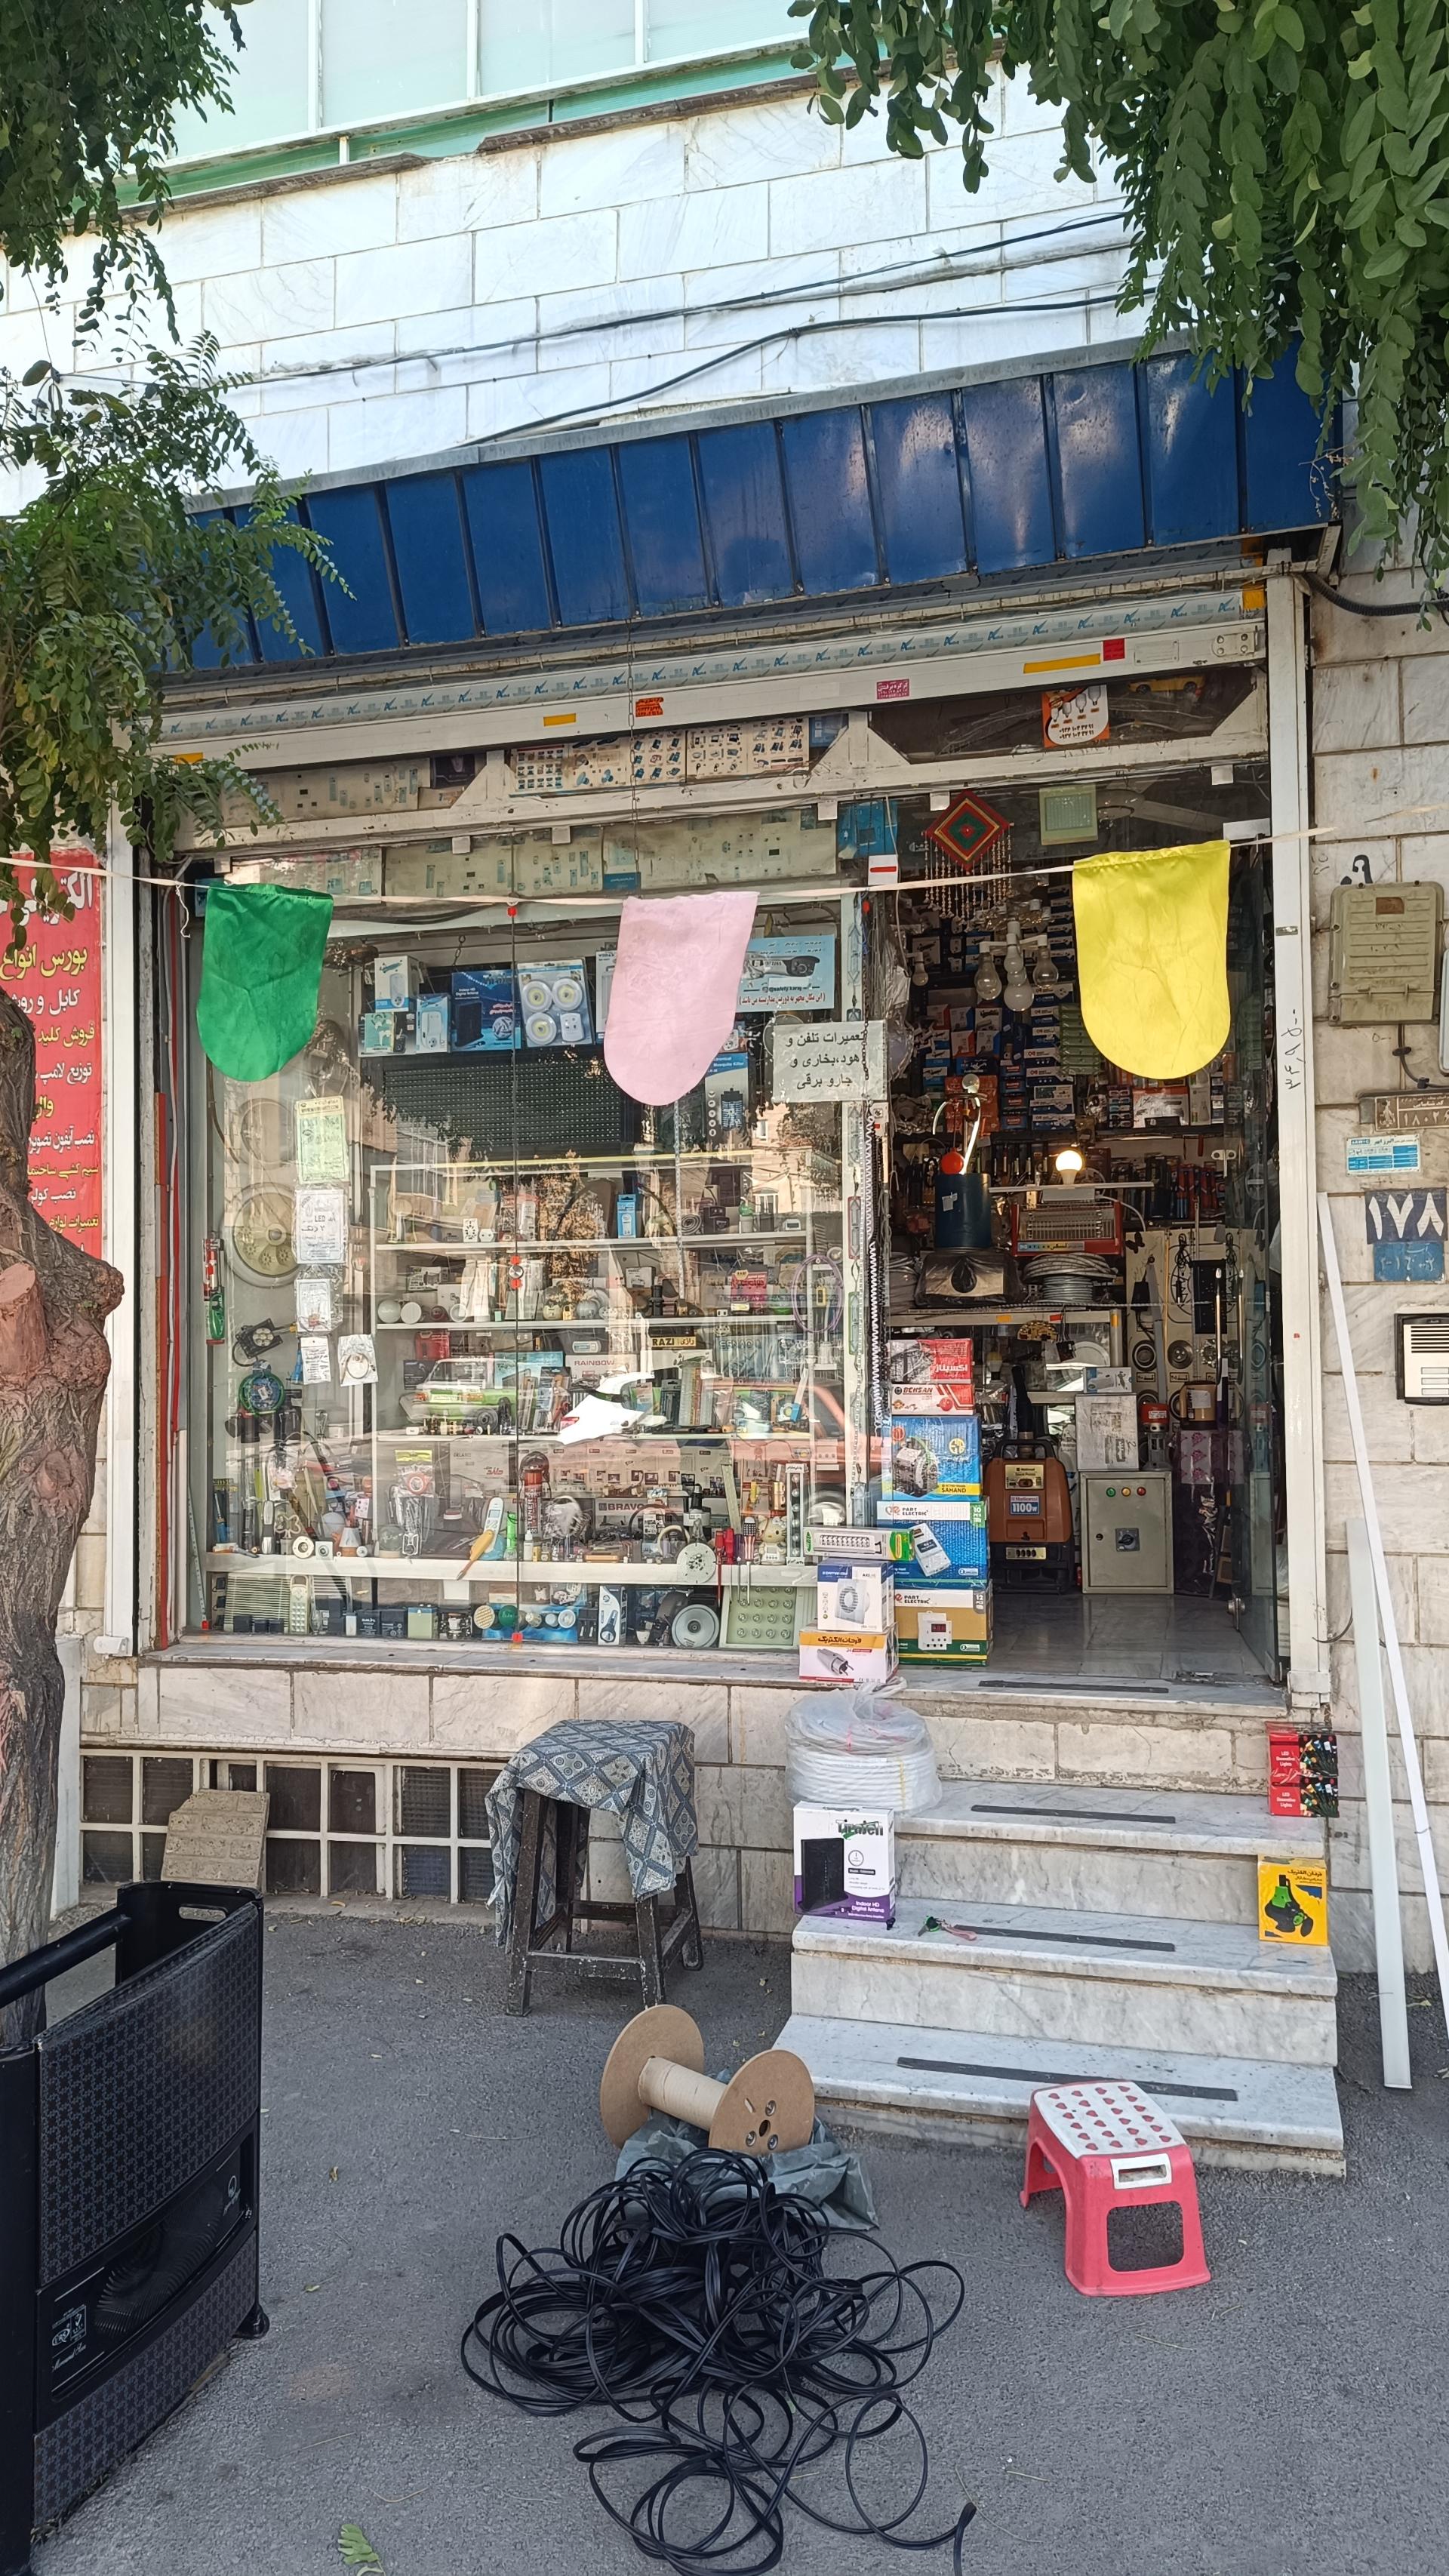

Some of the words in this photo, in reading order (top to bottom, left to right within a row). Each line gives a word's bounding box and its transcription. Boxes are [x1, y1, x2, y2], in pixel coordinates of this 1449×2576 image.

[41, 947, 88, 977] بورس
[36, 995, 45, 1015] و
[49, 988, 80, 1016] کابل
[38, 1026, 61, 1046] کلید
[63, 1022, 95, 1048] فروش
[786, 1038, 793, 1048] و
[796, 1033, 820, 1047] تلفن
[823, 1030, 866, 1045] تعمیرات
[792, 1057, 798, 1068] و
[40, 1063, 66, 1085] لامپ
[67, 1063, 93, 1084] توزیع
[797, 1073, 823, 1090] برقی
[826, 1075, 853, 1088] جارو
[28, 1132, 52, 1155] تصویر
[53, 1125, 74, 1153] آیفون
[74, 1131, 95, 1146] نصب
[27, 1163, 57, 1176] ساختما
[58, 1162, 81, 1180] کشی
[82, 1165, 100, 1178] سیم
[51, 1188, 76, 1201] نصب
[69, 1214, 99, 1233] تعمیرات
[1368, 1192, 1444, 1240] ۱۷۸
[817, 1636, 842, 1644] الکتریک
